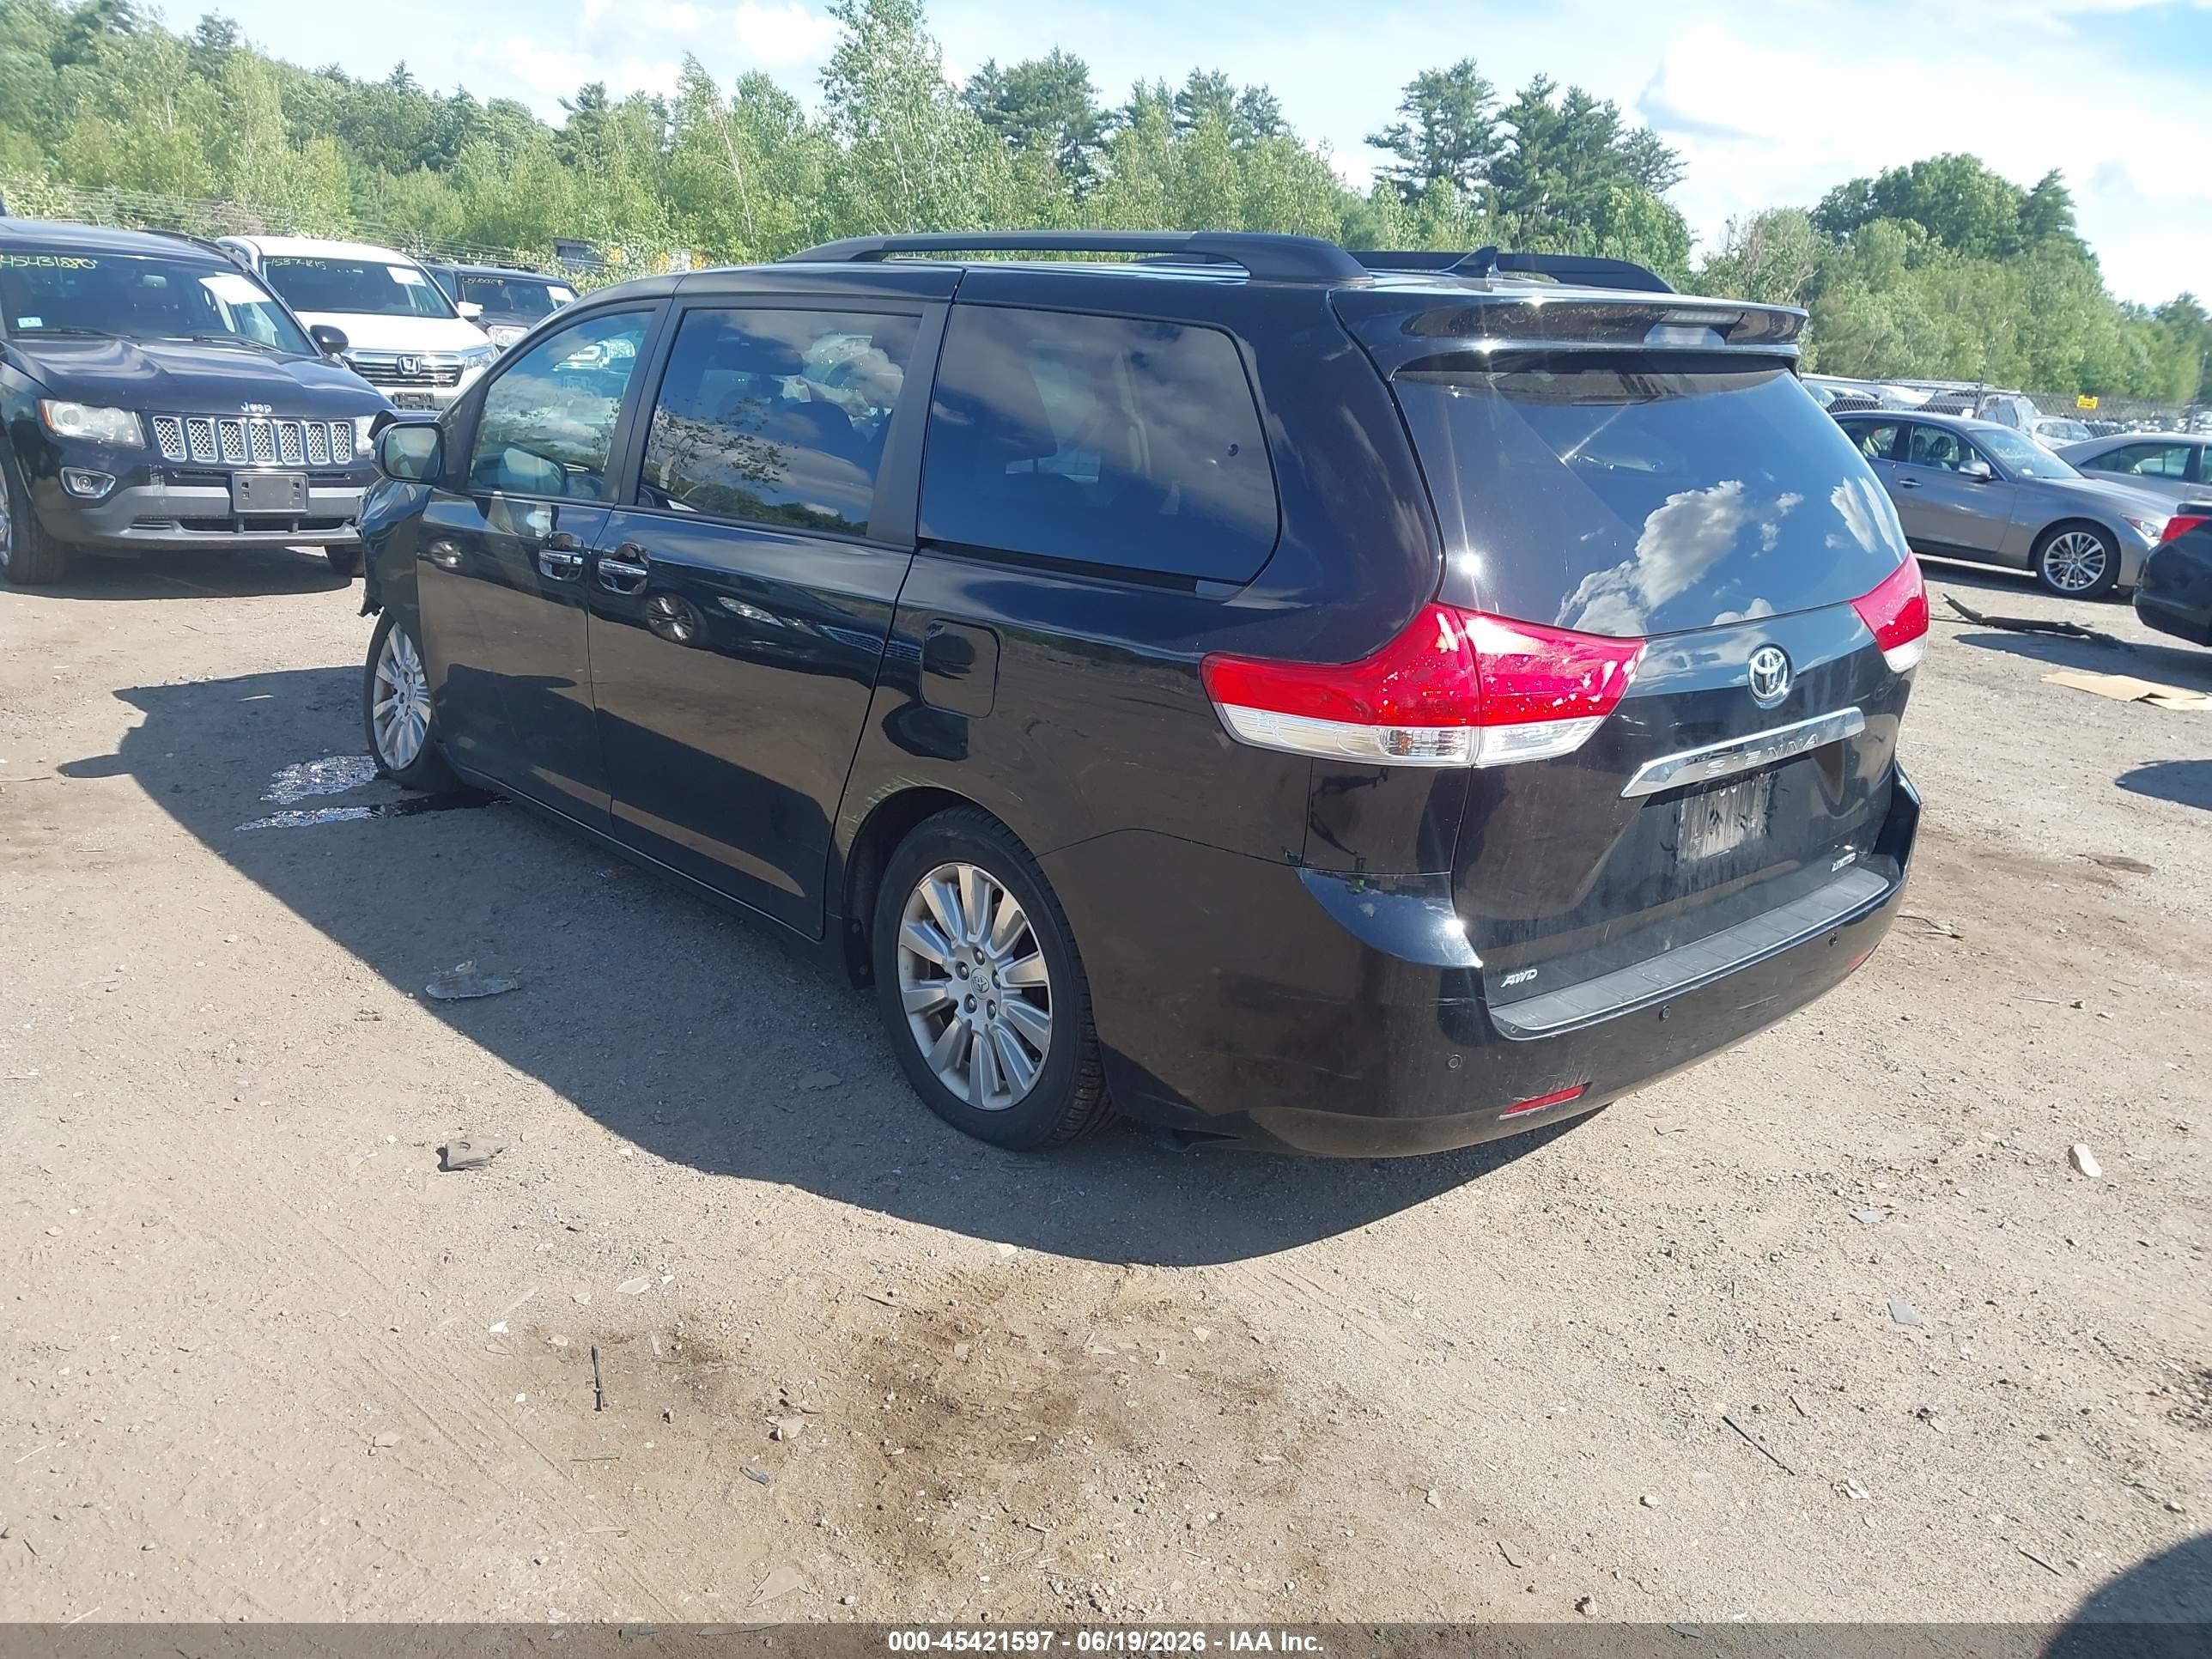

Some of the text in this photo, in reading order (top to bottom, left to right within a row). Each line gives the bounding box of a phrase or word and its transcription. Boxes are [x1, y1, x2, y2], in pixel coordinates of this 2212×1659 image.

[240, 401, 272, 413] Jeep
[1705, 733, 1819, 776] SIENNA
[1500, 969, 1538, 988] AWD
